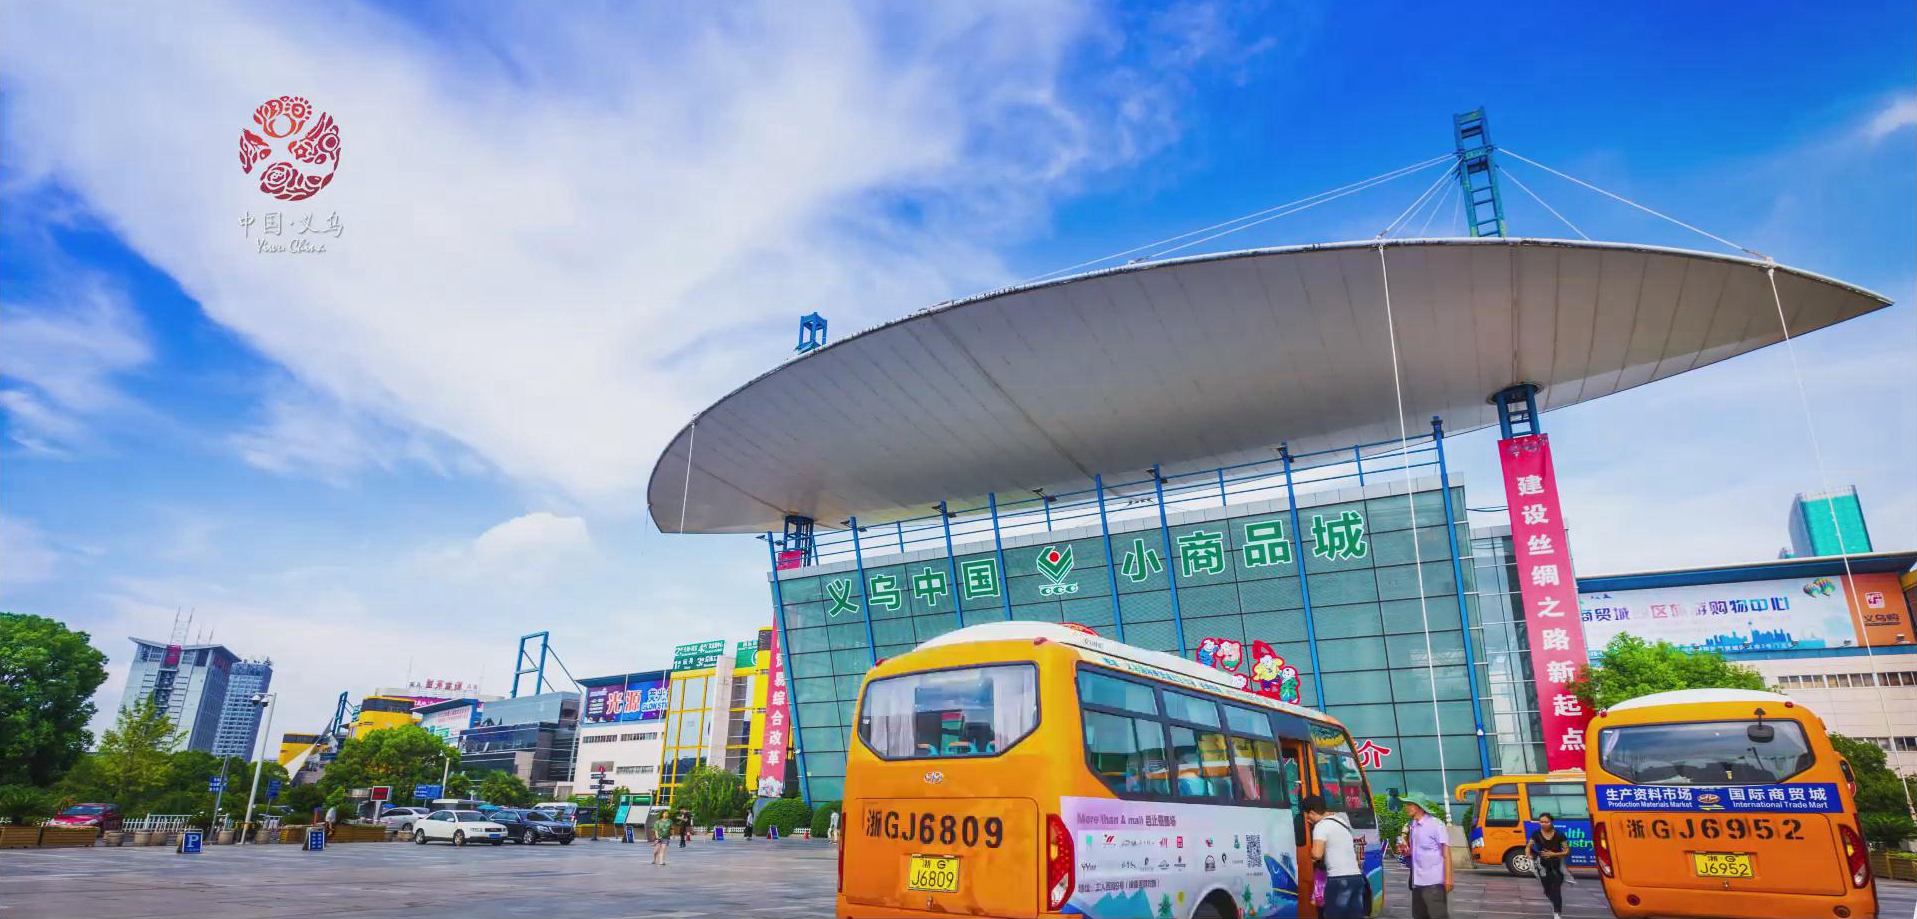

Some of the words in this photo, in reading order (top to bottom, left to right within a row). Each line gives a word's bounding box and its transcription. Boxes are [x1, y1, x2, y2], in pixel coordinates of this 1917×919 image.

[827, 558, 1000, 618] 义乌中国
[1121, 511, 1369, 583] 小商品城
[1516, 474, 1586, 752] 建设丝绸之路新起点
[606, 689, 642, 715] 光源
[1606, 788, 1693, 801] 生产资料市场
[1728, 787, 1828, 801] 国际商贸城
[1077, 813, 1099, 824] More
[1101, 814, 1119, 825] than
[187, 834, 200, 848] P
[1700, 863, 1749, 876] J6952
[911, 871, 955, 887] J6809
